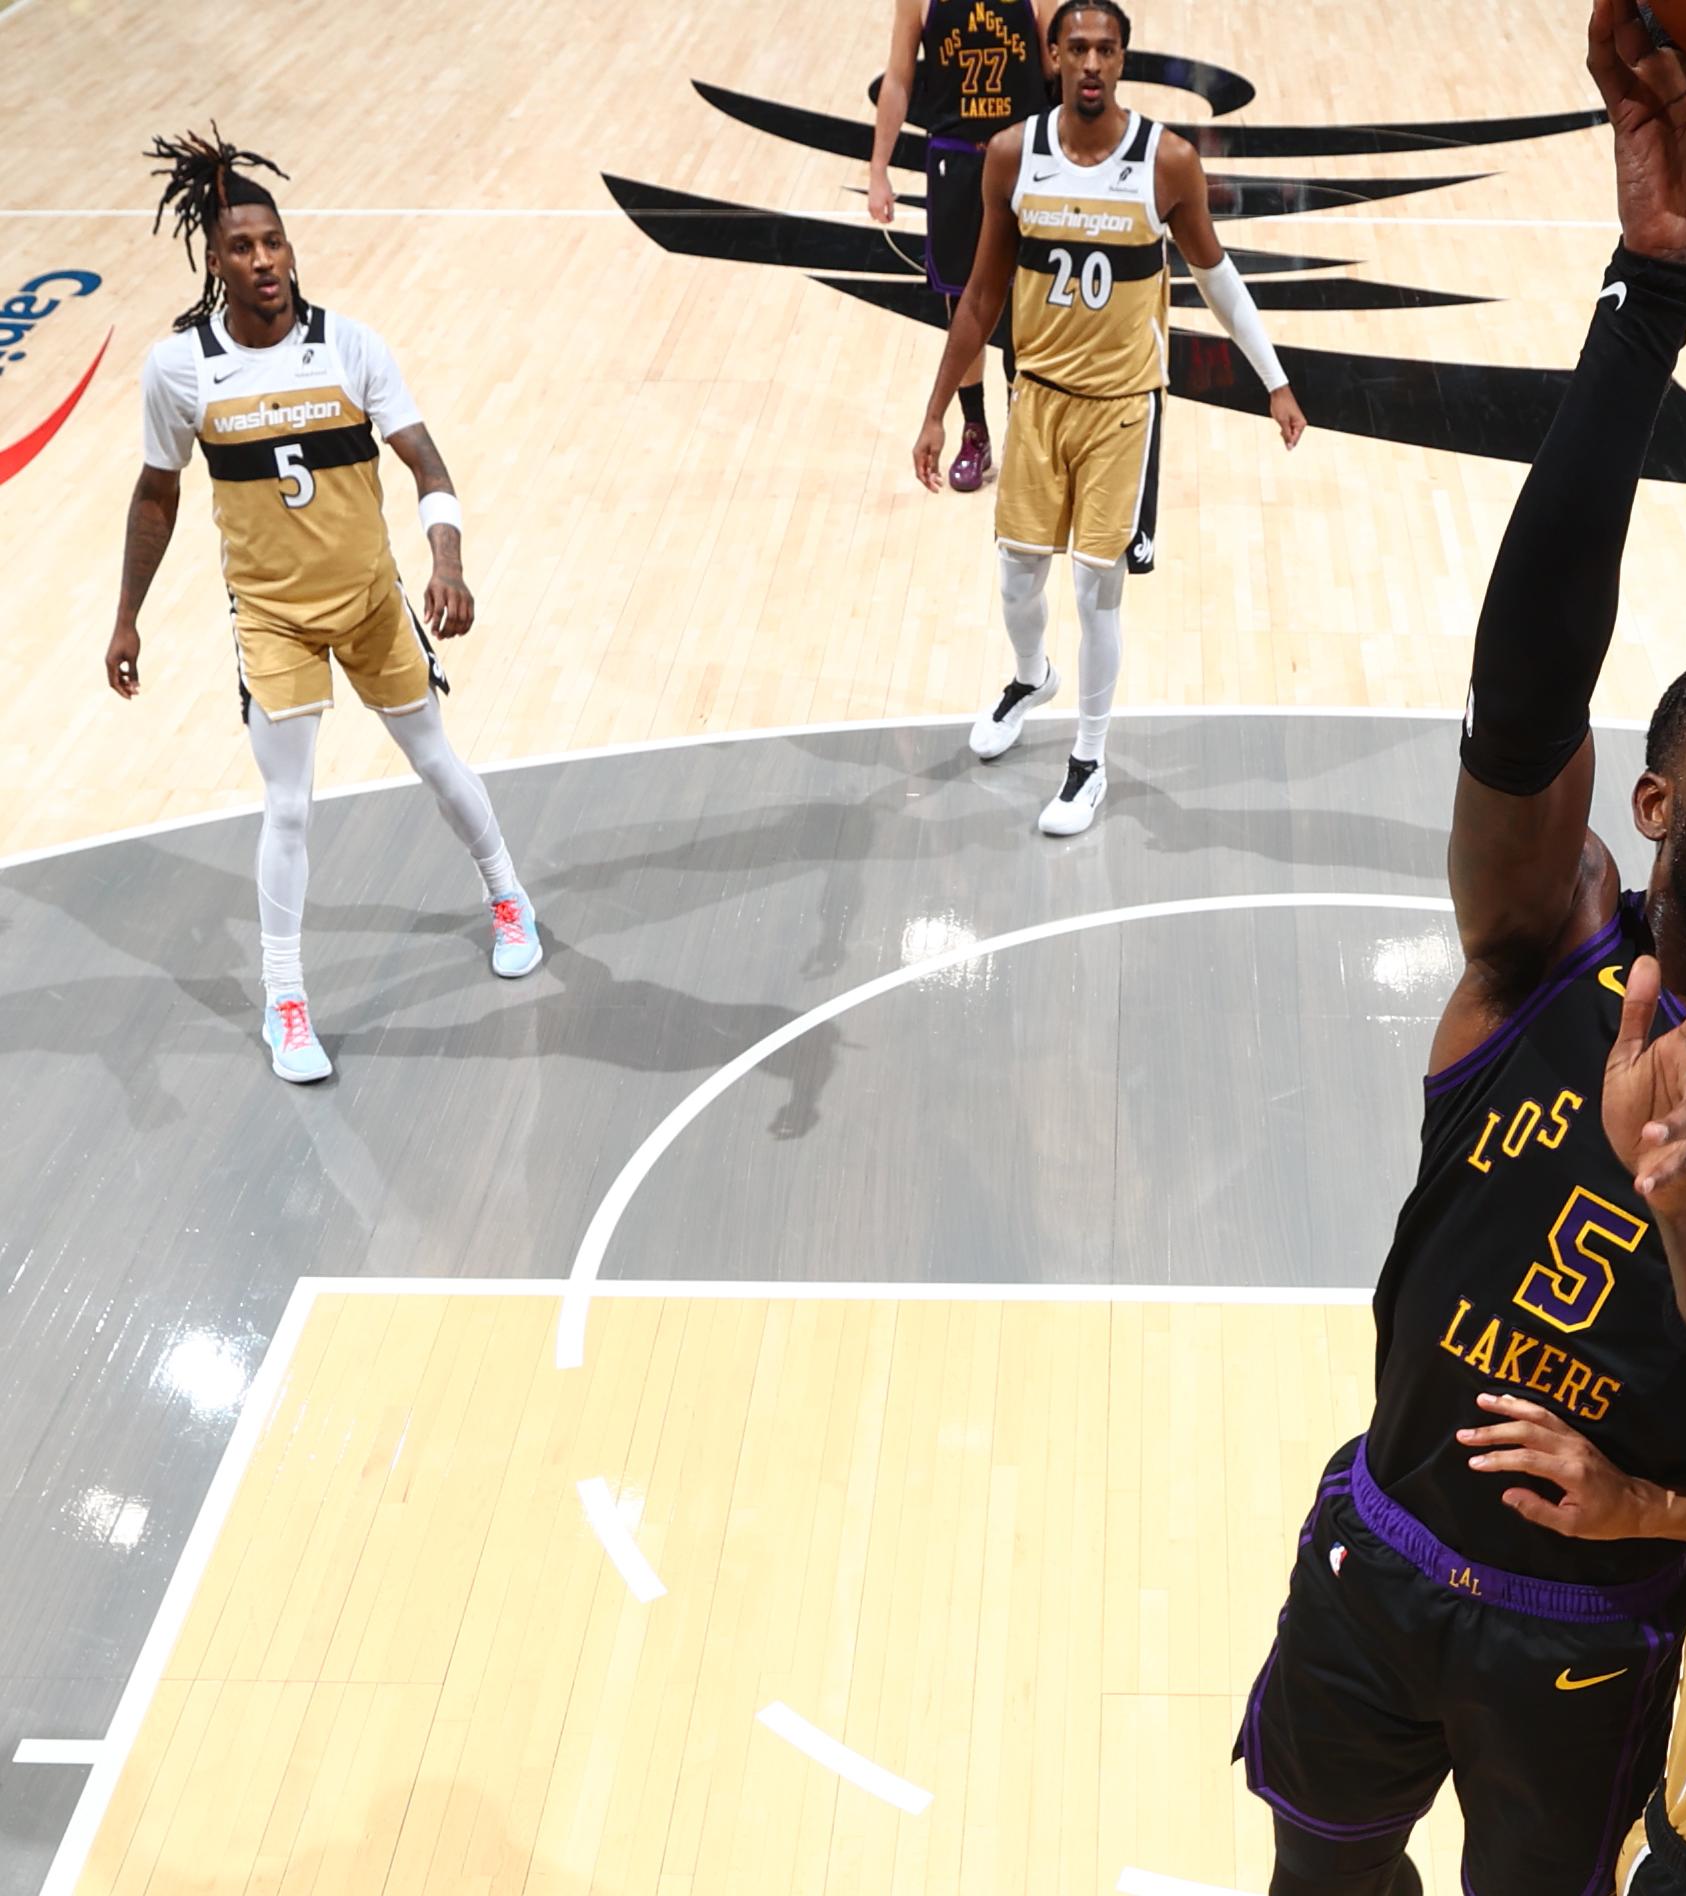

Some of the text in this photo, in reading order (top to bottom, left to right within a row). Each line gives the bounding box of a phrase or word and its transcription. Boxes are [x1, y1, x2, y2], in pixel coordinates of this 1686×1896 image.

[940, 2, 1026, 66] LOS ANGELES
[959, 47, 1008, 94] 77
[961, 97, 1012, 118] LAKERS
[1022, 204, 1134, 237] washington
[1047, 247, 1114, 311] 20
[213, 400, 341, 433] washington
[274, 443, 317, 508] 5
[1467, 1089, 1584, 1173] LOS
[1512, 1184, 1649, 1333] 5
[1440, 1298, 1622, 1421] LAKERS
[1449, 1567, 1482, 1596] LAL
